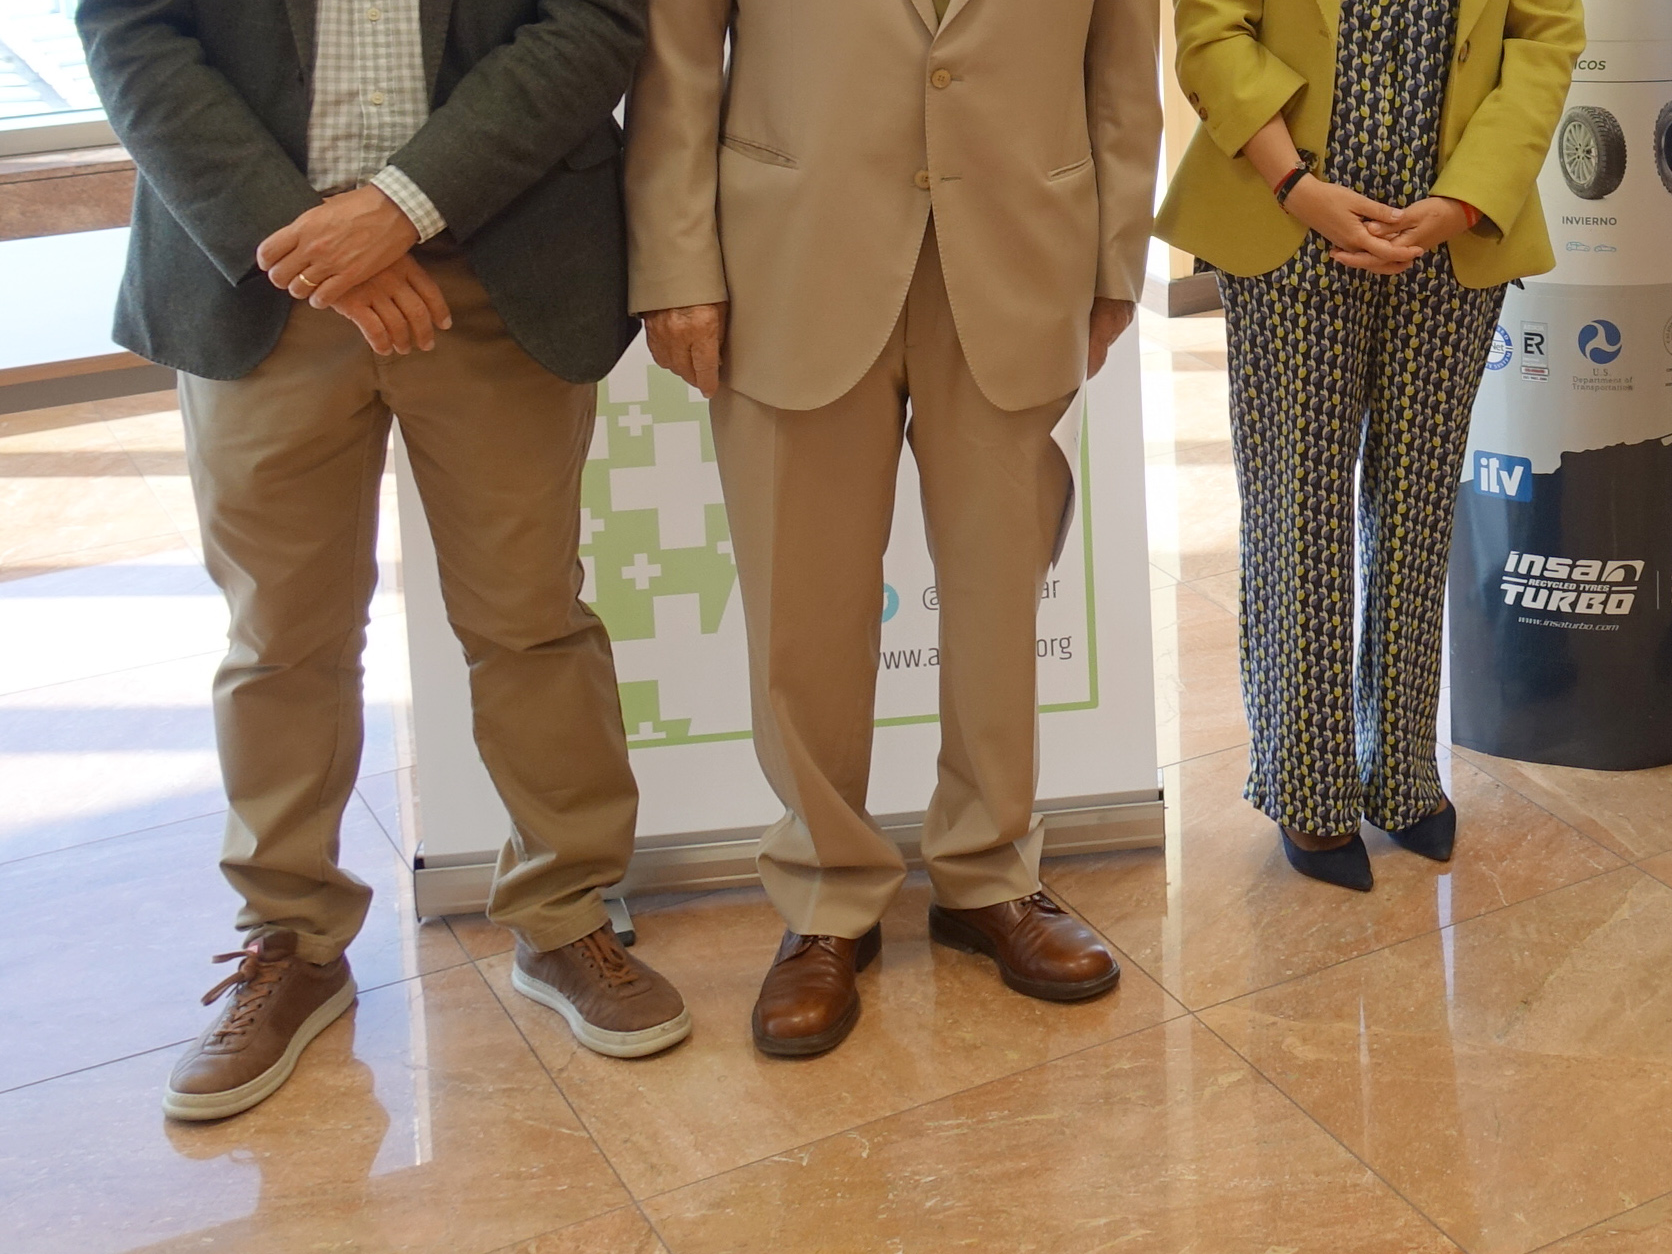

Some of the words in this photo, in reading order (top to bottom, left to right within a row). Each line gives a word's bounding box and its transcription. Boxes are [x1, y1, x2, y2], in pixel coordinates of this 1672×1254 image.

[1562, 216, 1617, 226] INVIERNO
[1572, 375, 1622, 384] Department
[1572, 383, 1633, 392] Transportation
[1528, 578, 1577, 591] RECYCLED
[1579, 583, 1611, 592] TYRES
[1500, 583, 1635, 615] TURBO
[1518, 616, 1620, 632] www.insaturbo.com
